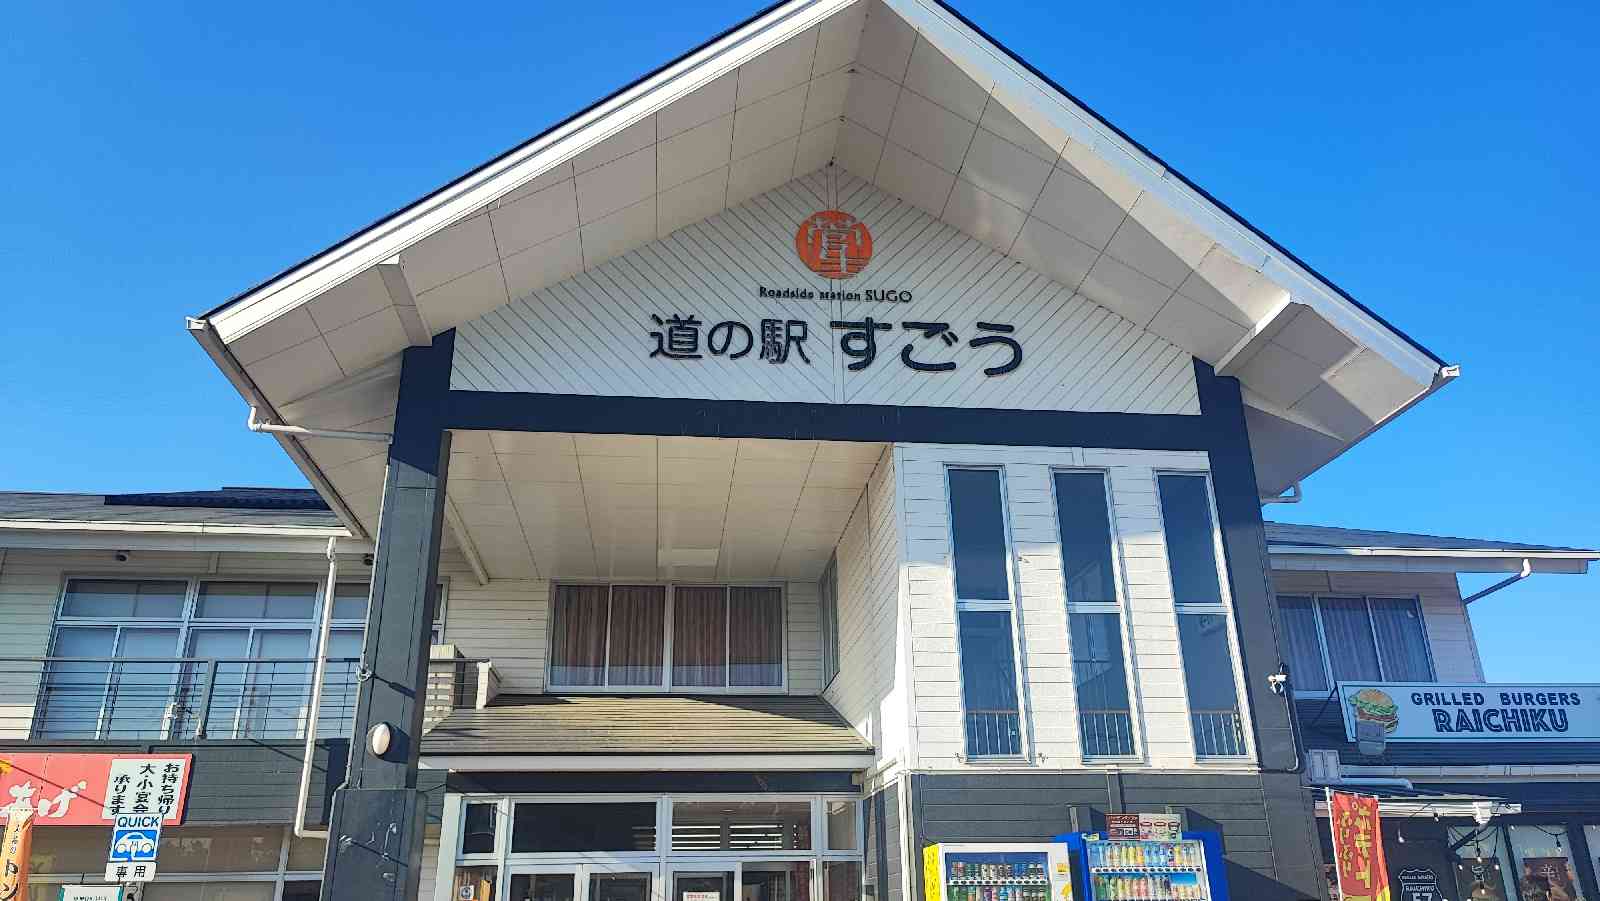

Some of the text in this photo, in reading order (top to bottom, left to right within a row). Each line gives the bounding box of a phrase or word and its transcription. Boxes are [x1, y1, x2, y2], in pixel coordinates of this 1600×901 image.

[759, 286, 913, 304] Roadside station SUGO
[649, 314, 1023, 376] 道の駅 すごう
[1411, 692, 1581, 706] GRILLED BURGERS
[1432, 708, 1569, 733] RAICHIKU
[110, 774, 130, 816] 承ります
[158, 763, 180, 815] お持ち帰り
[117, 816, 159, 828] QUICK
[116, 865, 146, 878] 専用
